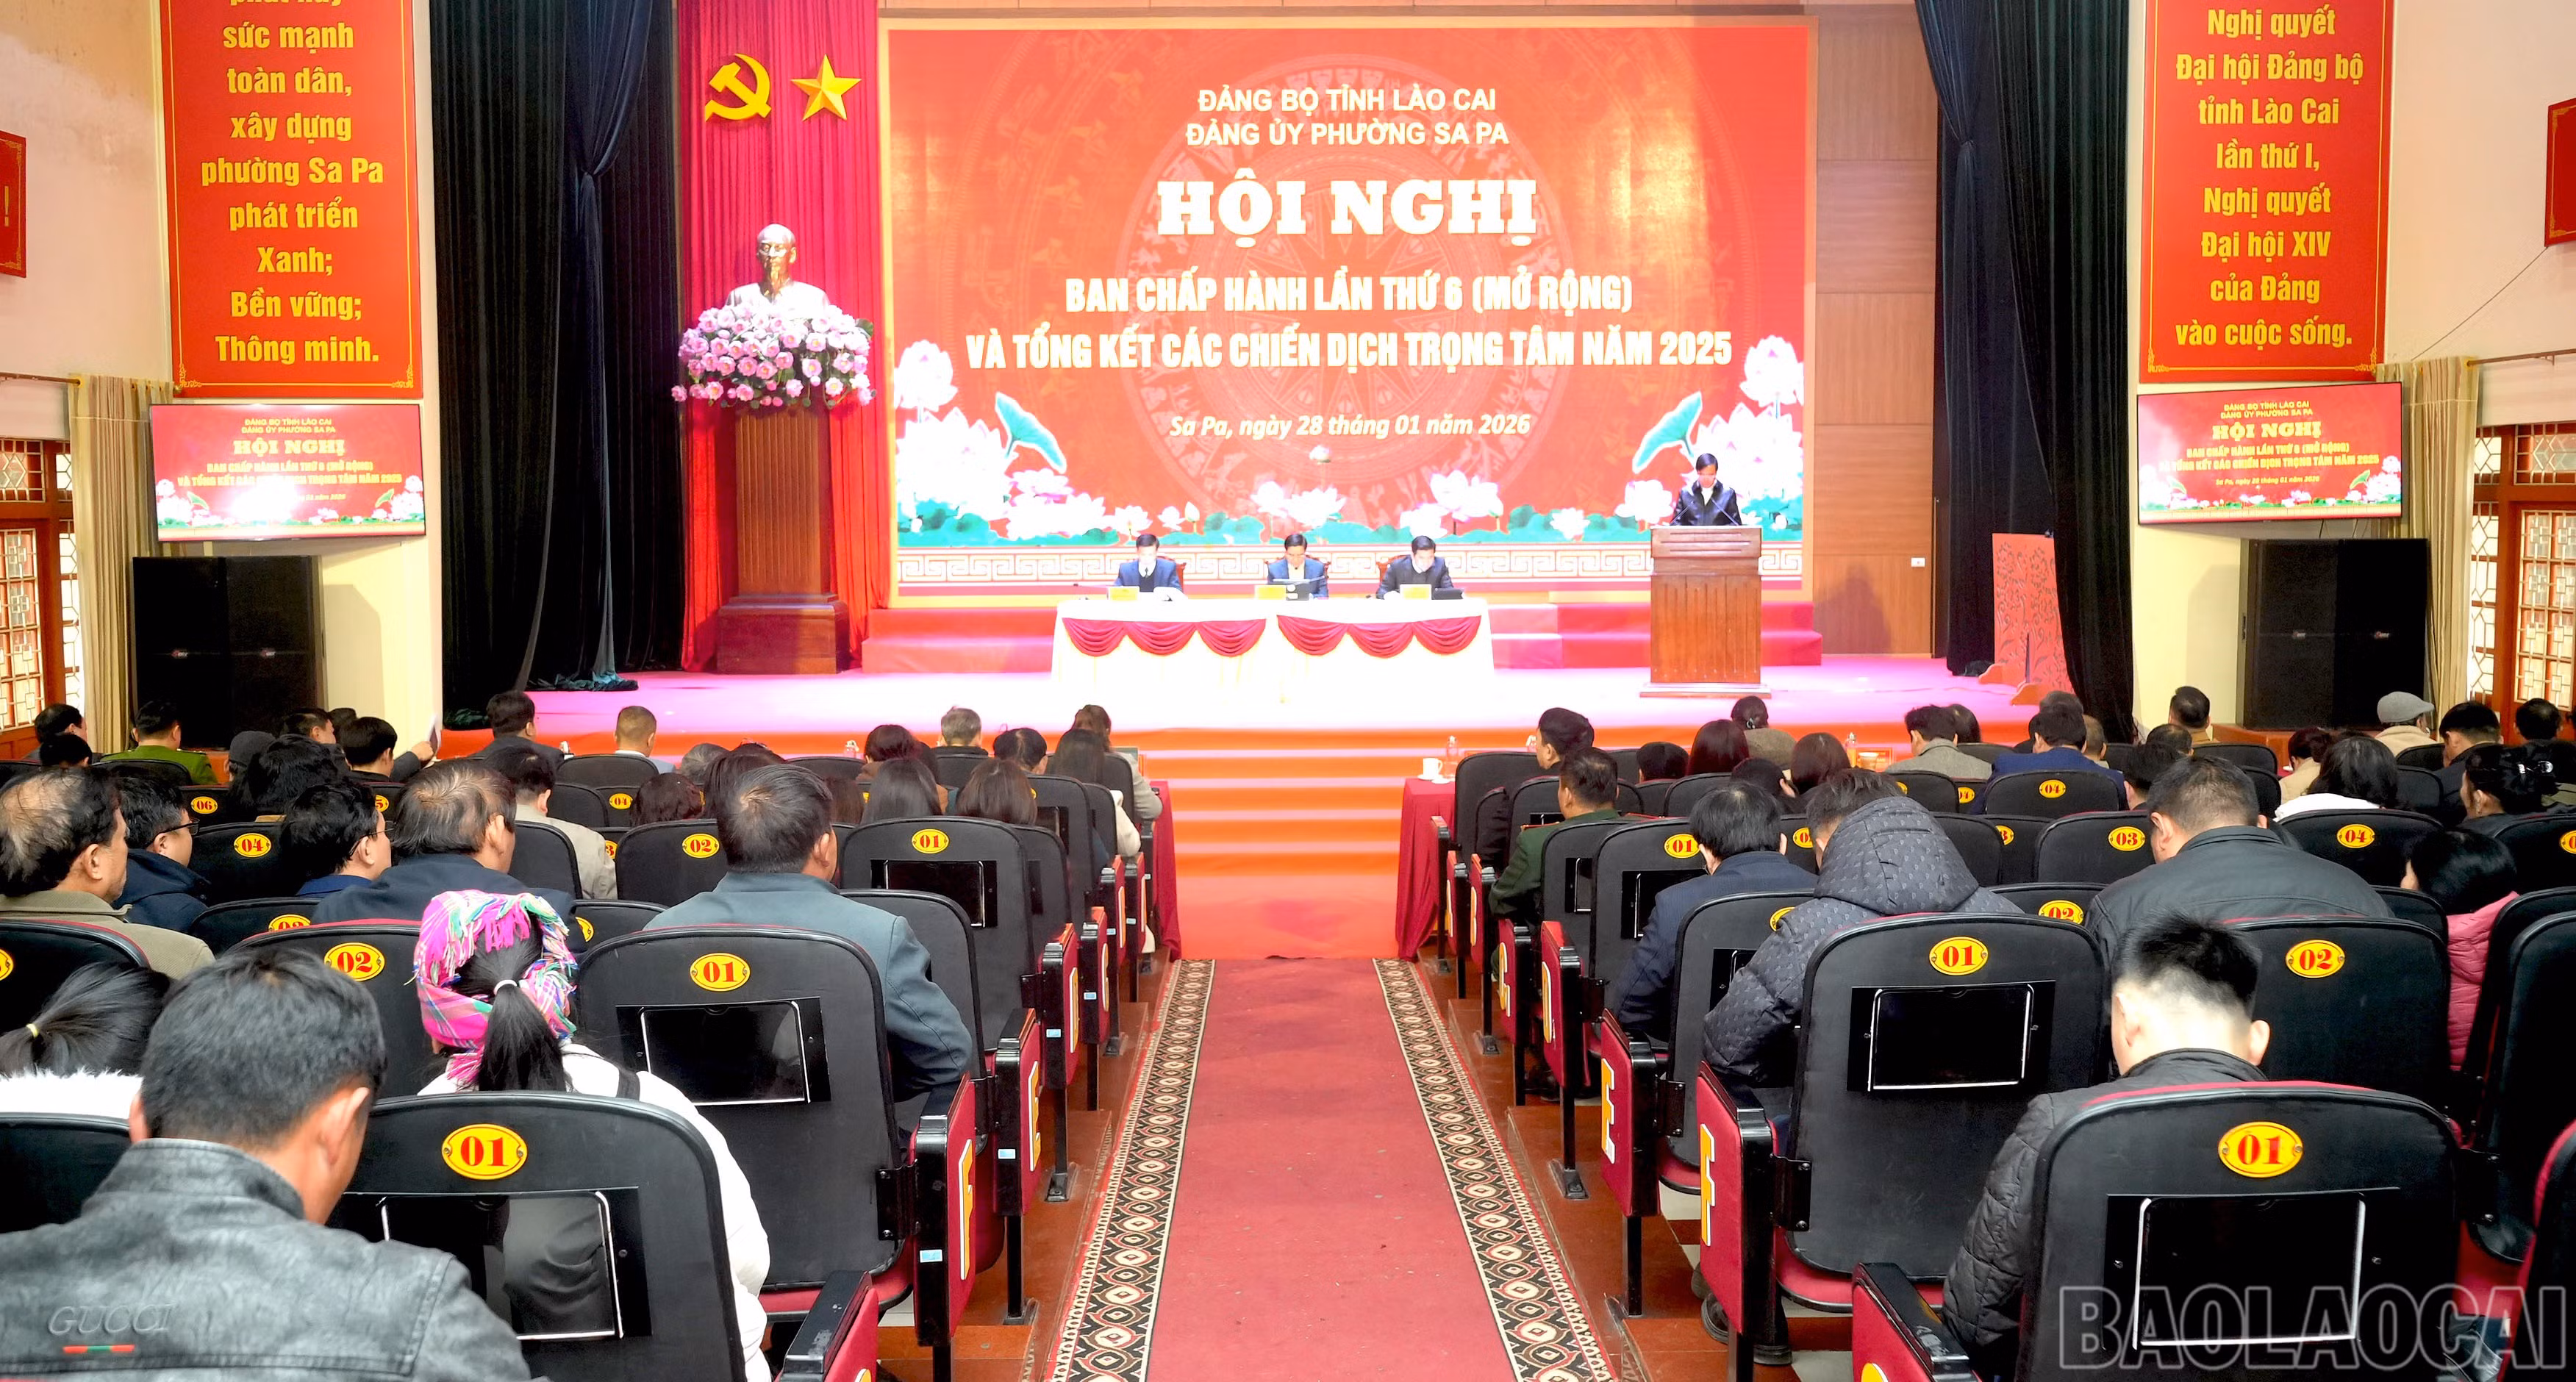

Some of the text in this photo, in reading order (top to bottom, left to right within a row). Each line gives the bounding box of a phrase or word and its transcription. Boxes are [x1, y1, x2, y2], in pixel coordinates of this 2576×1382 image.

[2208, 4, 2335, 40] Nghị quyết
[223, 22, 353, 54] sức mạnh
[227, 67, 351, 96] toàn dân,
[2176, 51, 2363, 85] Đại hội Đảng bộ
[1198, 83, 1495, 116] ĐẢNG BỘ TỈNH LÀO CAI
[2198, 95, 2339, 124] tỉnh Lào Cai
[231, 112, 351, 144] xây dựng
[1186, 118, 1509, 146] ĐẢNG ỦY PHƯỜNG SA PA
[2217, 138, 2319, 171] lần thứ I,
[202, 157, 384, 186] phường Sa Pa
[230, 196, 358, 231] phát triển
[1157, 168, 1536, 248] HỘI NGHỊ
[2204, 182, 2330, 218] Nghị quyết
[2201, 231, 2330, 262] Đại hội XIV
[258, 247, 332, 276] Xanh;
[1066, 265, 1632, 317] BAN CHẤP HÀNH LẦN THỨ 6 (MỞ RỘNG)
[2211, 273, 2319, 304] của Đảng
[232, 287, 362, 321] Bền vững;
[2176, 315, 2352, 350] vào cuộc sống.
[215, 335, 379, 365] Thông minh.
[966, 321, 1731, 374] VÀ TỔNG KẾT CÁC CHIẾN DỊCH TRỌNG TÂM NĂM 2025
[1170, 413, 1531, 440] Sa Pa, ngày 28 tháng 01 năm 2026
[2212, 421, 2321, 441] HỘI NGHỊ
[233, 437, 345, 457] HỘI NGHỊ
[197, 801, 212, 810] 06
[242, 839, 263, 851] 04
[691, 839, 711, 852] 02
[920, 836, 940, 847] 01
[1673, 840, 1691, 852] 01
[2117, 833, 2137, 845] 03
[2345, 831, 2365, 842] 04
[338, 952, 372, 972] 02
[1944, 946, 1974, 966] 01
[2300, 950, 2331, 970] 02
[704, 962, 737, 982] 01
[461, 1137, 509, 1166] 01
[2238, 1135, 2281, 1164] 01
[1700, 1123, 1715, 1246] F
[48, 1304, 177, 1336] GUCCI
